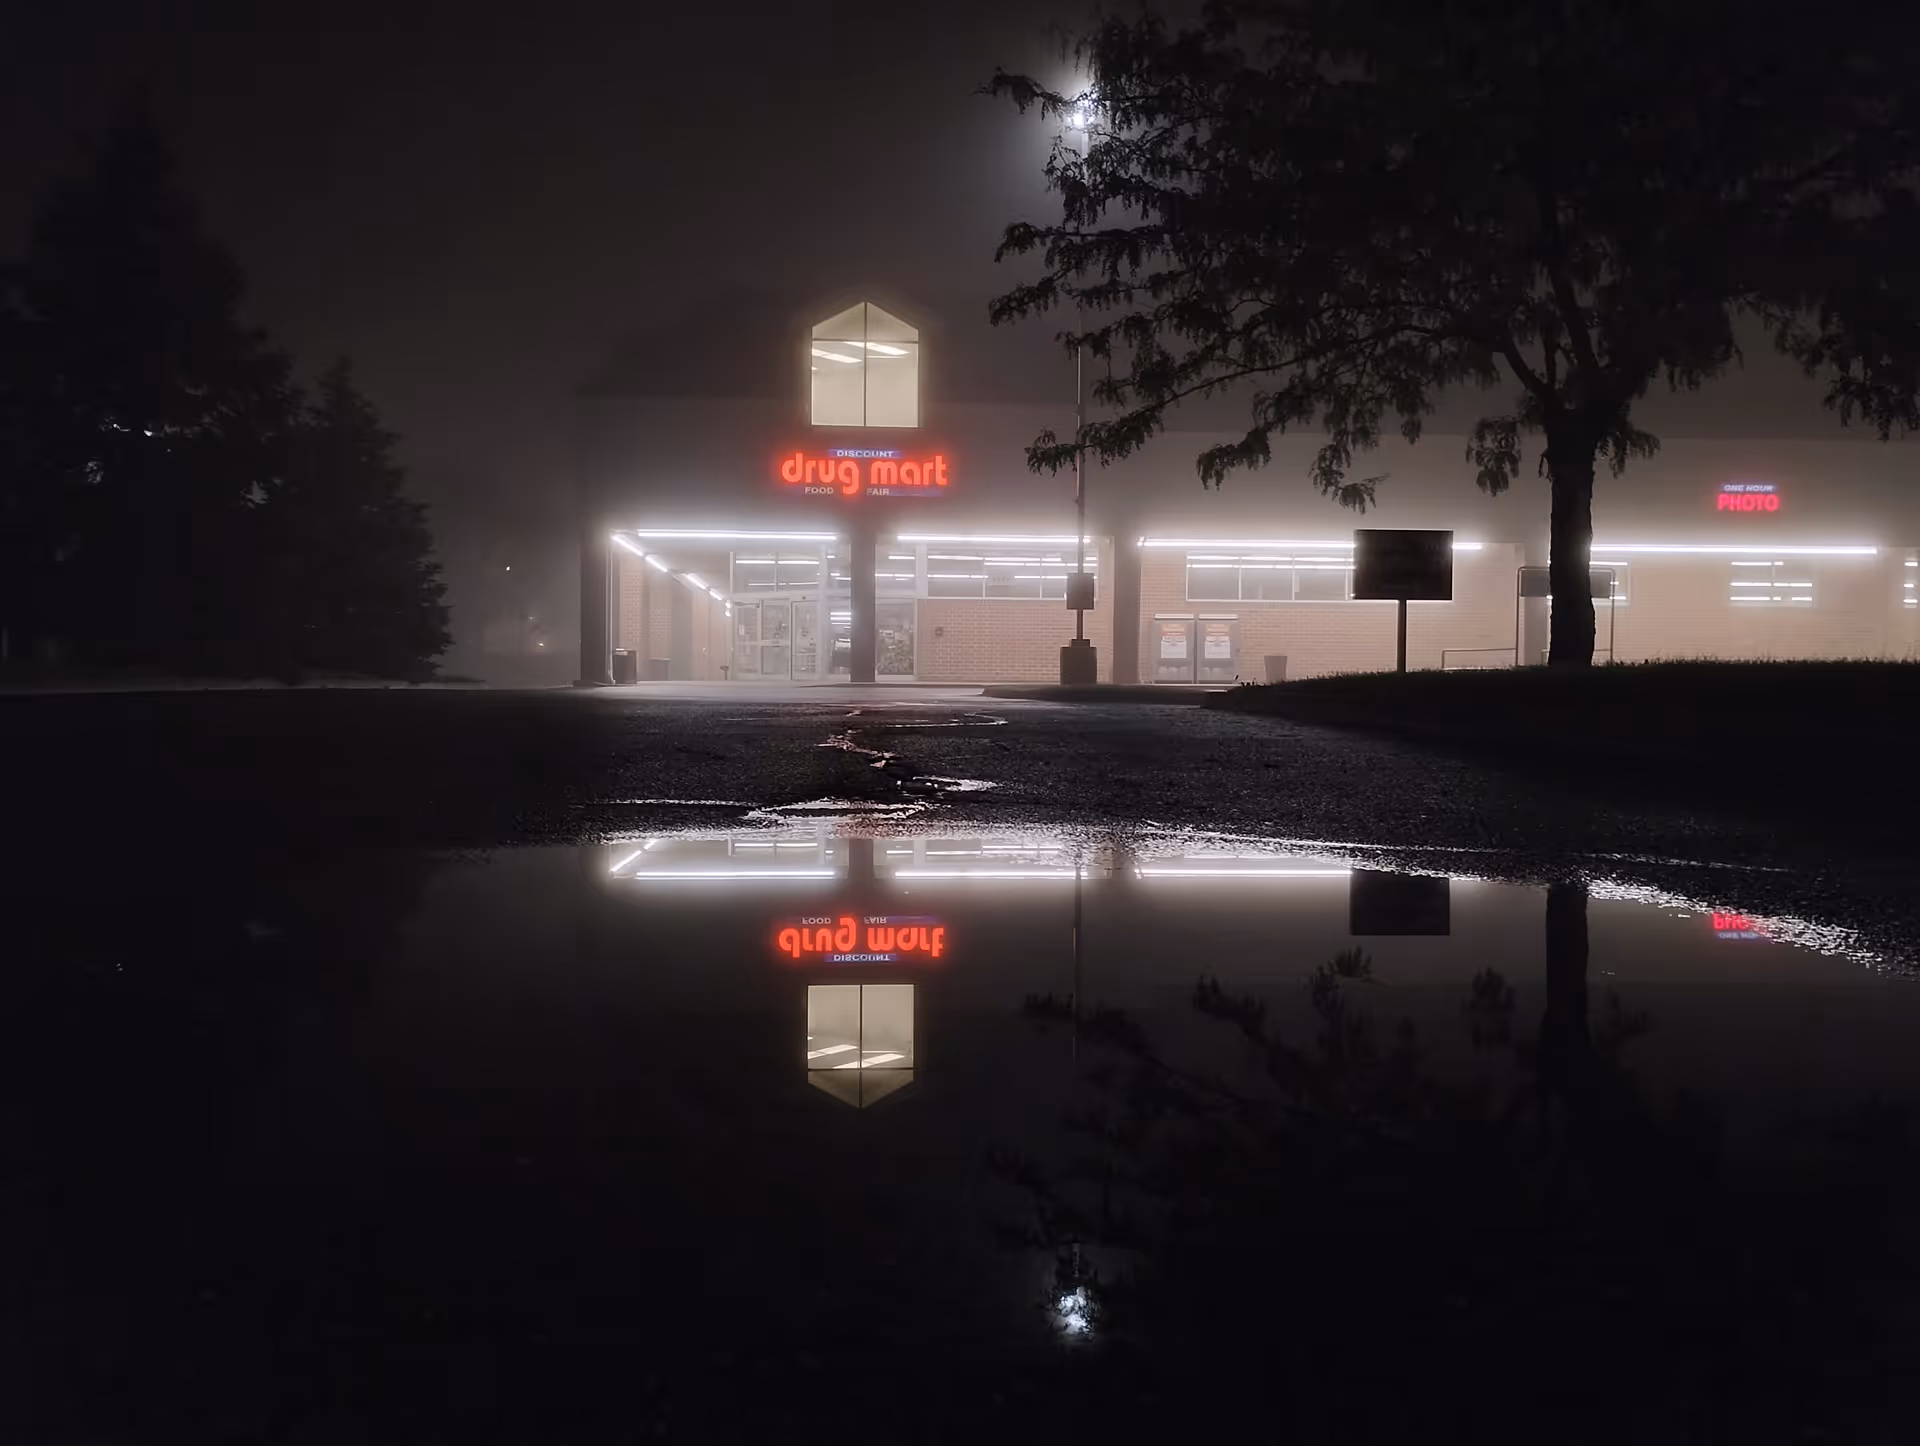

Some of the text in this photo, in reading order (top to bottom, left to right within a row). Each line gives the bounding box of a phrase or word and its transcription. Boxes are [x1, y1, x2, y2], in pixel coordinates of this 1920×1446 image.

[836, 450, 894, 458] DISCOUNT
[781, 452, 948, 495] drug mart
[804, 486, 890, 496] FOOD FAIR
[1723, 484, 1773, 492] ONE HOUR
[1717, 493, 1780, 511] PHOTO
